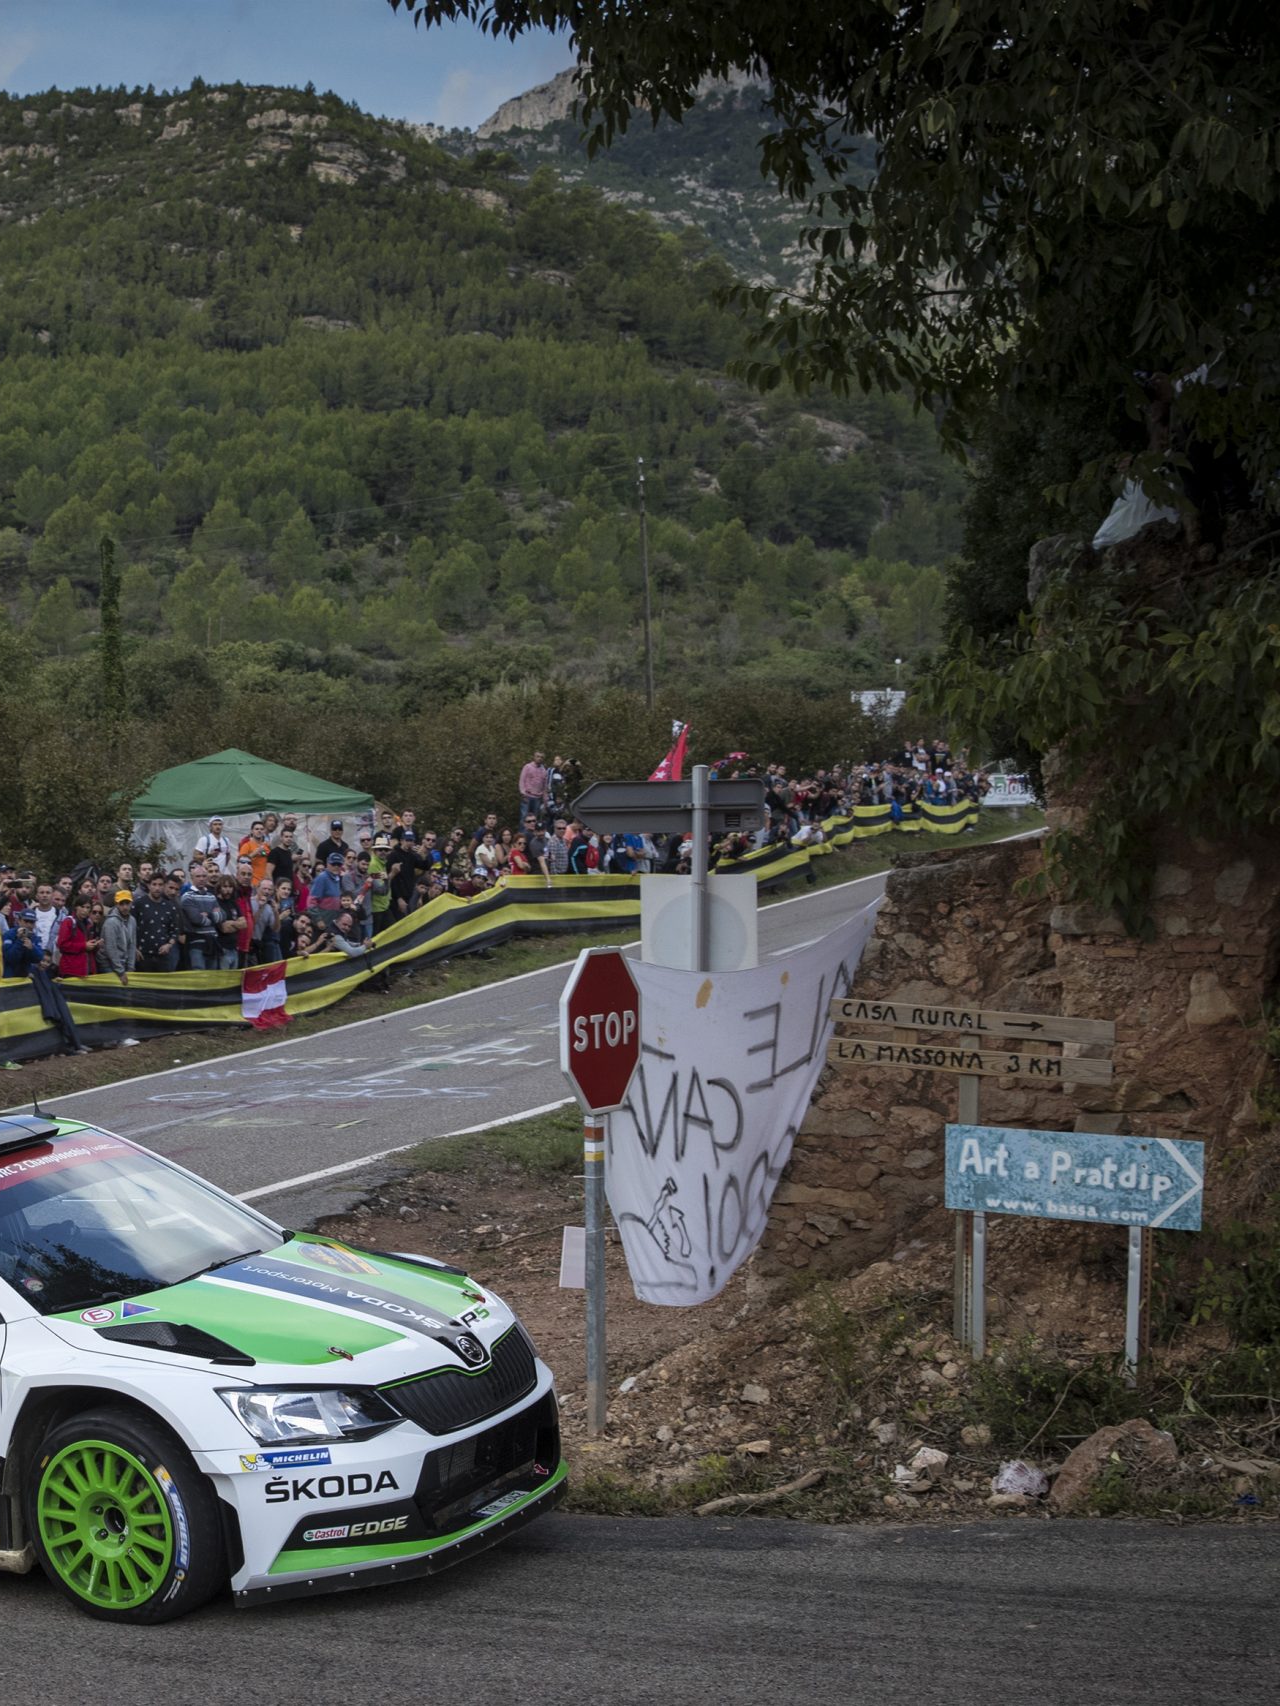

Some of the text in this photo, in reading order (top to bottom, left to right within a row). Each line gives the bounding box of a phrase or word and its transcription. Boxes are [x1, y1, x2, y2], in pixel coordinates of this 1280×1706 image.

[841, 1002, 988, 1030] CASA RURAL
[573, 1009, 637, 1052] STOP
[838, 1042, 1062, 1076] LA MASSONA 3 KM
[19, 1161, 25, 1172] 2
[24, 1146, 91, 1170] Championship
[958, 1138, 1172, 1201] Art a Pratdip
[241, 1265, 342, 1294] Motorsport
[460, 1307, 490, 1329] R5
[272, 1451, 329, 1463] MICHELIN
[264, 1470, 400, 1504] ŠKODA
[314, 1526, 346, 1540] Castrol
[349, 1514, 410, 1537] EDGE
